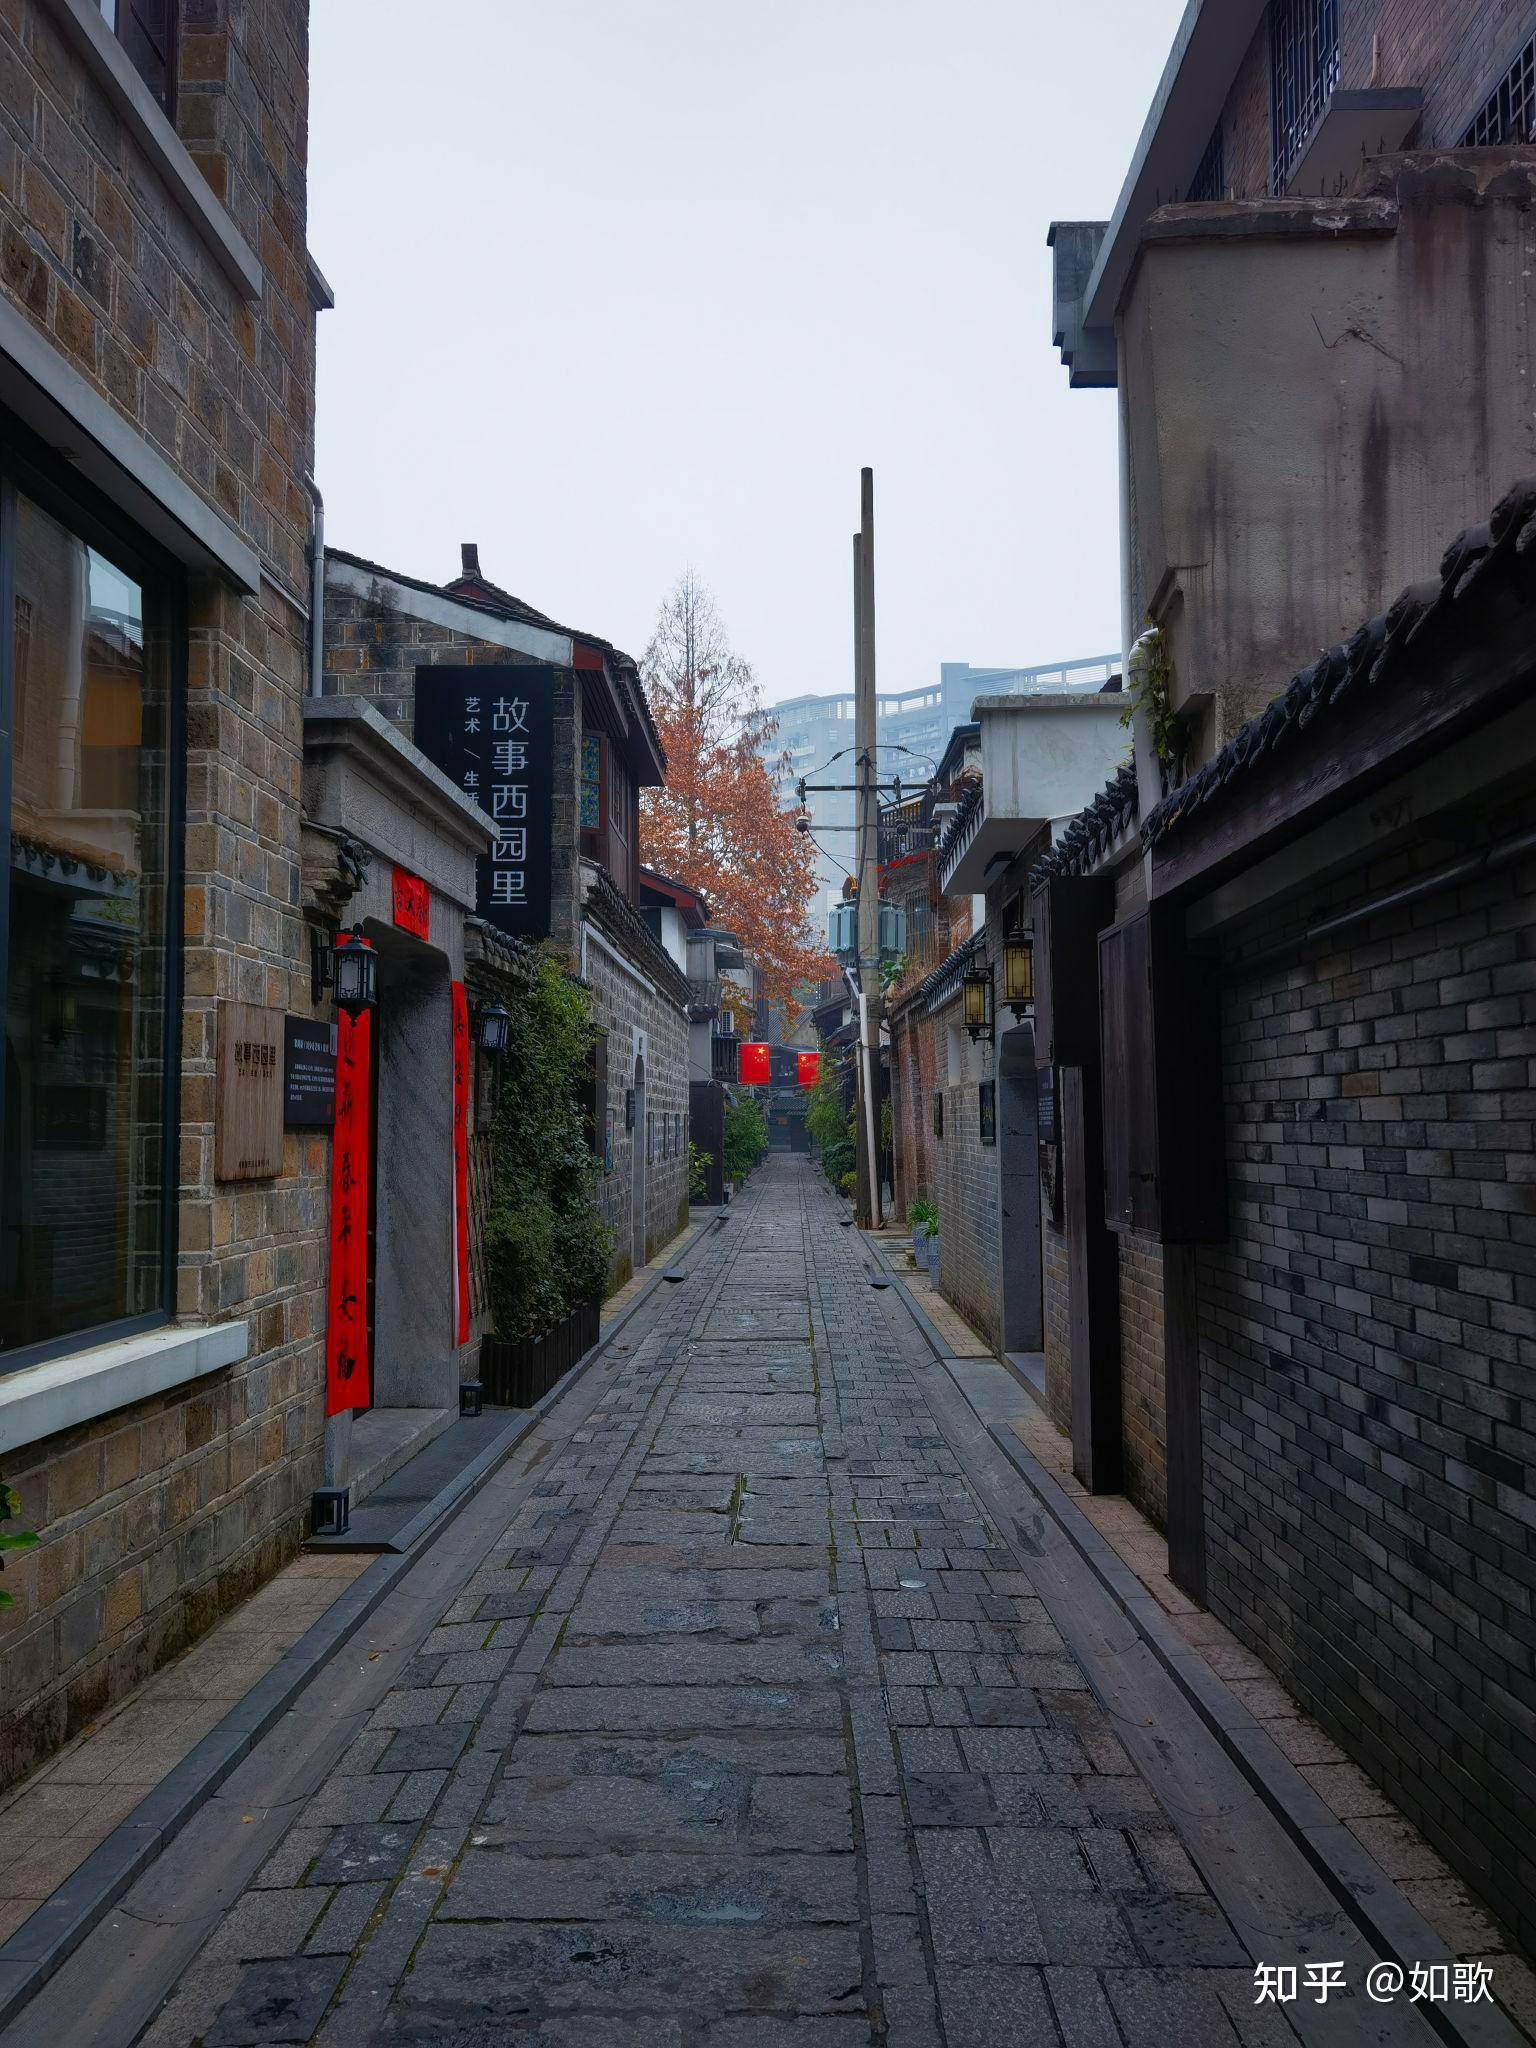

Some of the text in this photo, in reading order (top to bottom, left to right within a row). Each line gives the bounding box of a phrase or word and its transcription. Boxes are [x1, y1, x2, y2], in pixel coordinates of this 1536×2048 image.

[464, 696, 481, 733] 艺术
[490, 696, 530, 904] 故事西园里
